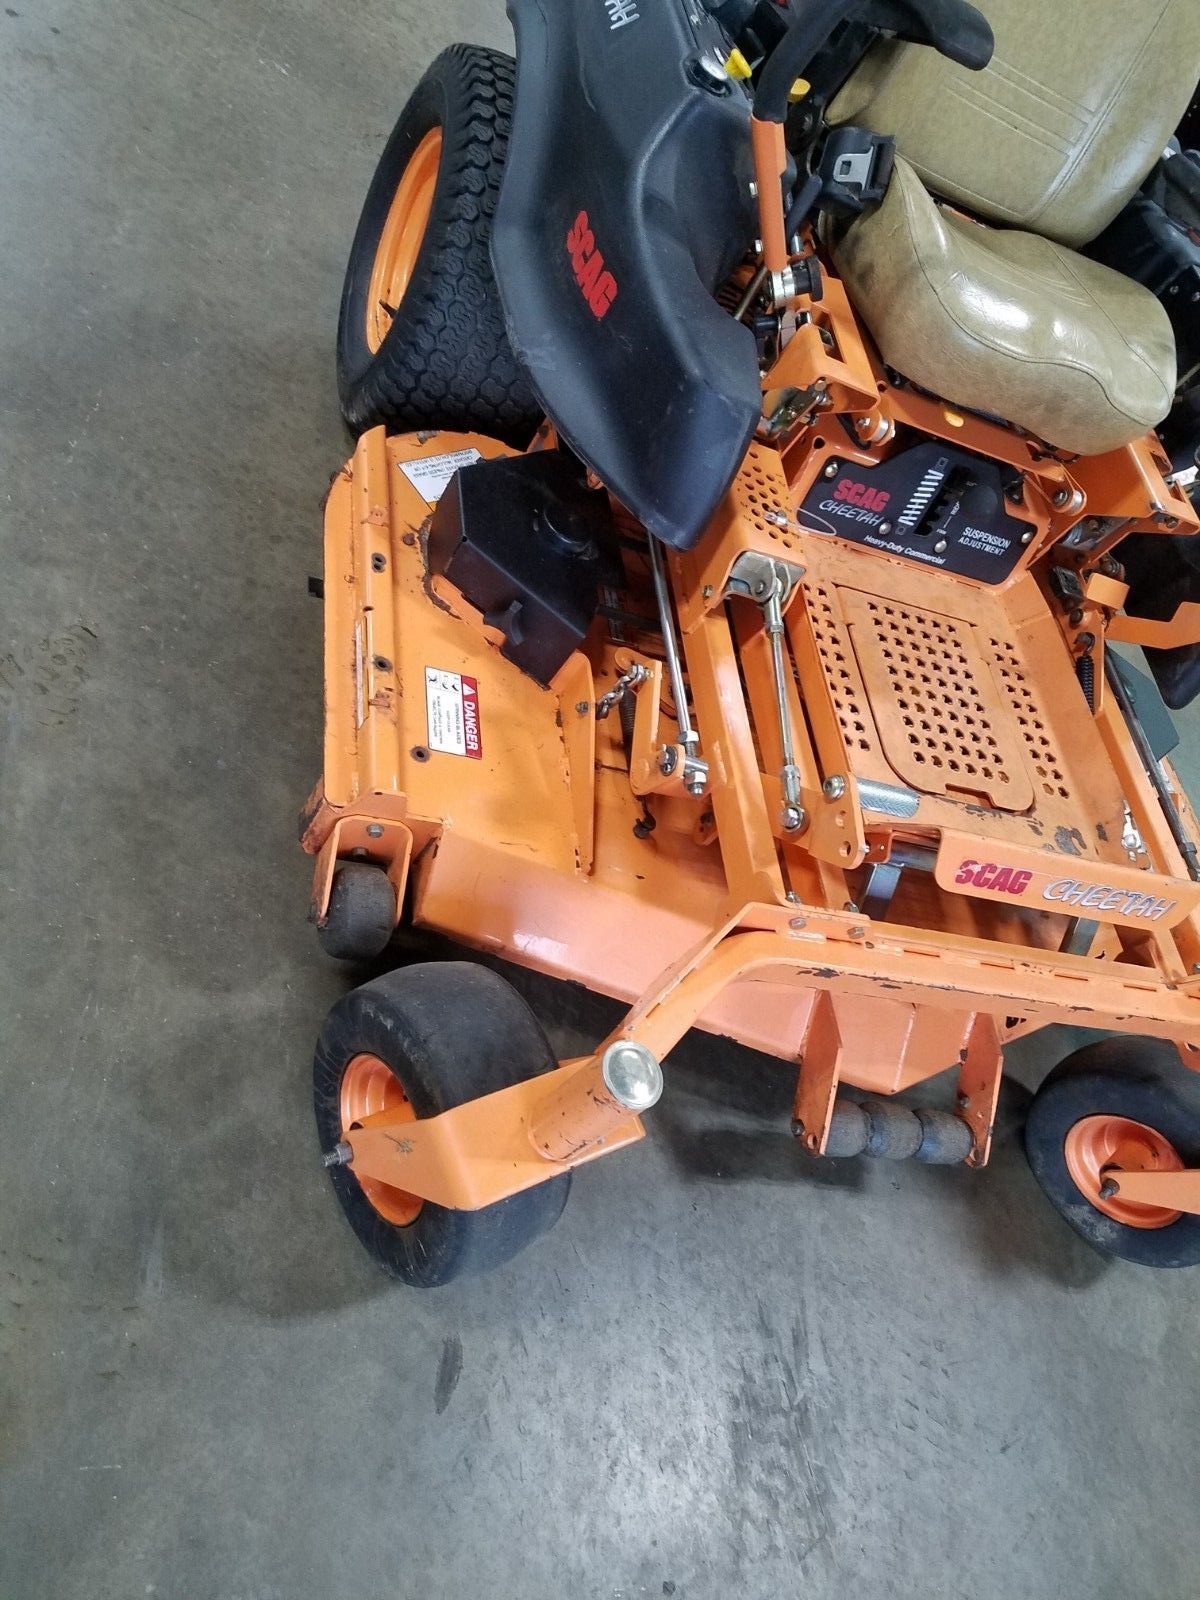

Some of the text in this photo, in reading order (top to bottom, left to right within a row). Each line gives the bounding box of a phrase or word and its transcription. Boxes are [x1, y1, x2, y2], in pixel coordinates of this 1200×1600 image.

[567, 210, 617, 318] SCAG
[833, 479, 891, 512] SCAG
[819, 500, 883, 526] CHEETAH
[864, 535, 946, 565] Heavy-Duty Commercial
[958, 537, 1005, 556] ADJUSTMENT
[963, 527, 1011, 549] SUSPENSION
[464, 701, 478, 750] DANGER
[955, 860, 1033, 895] SCAG
[1042, 878, 1176, 921] CHEETAH
